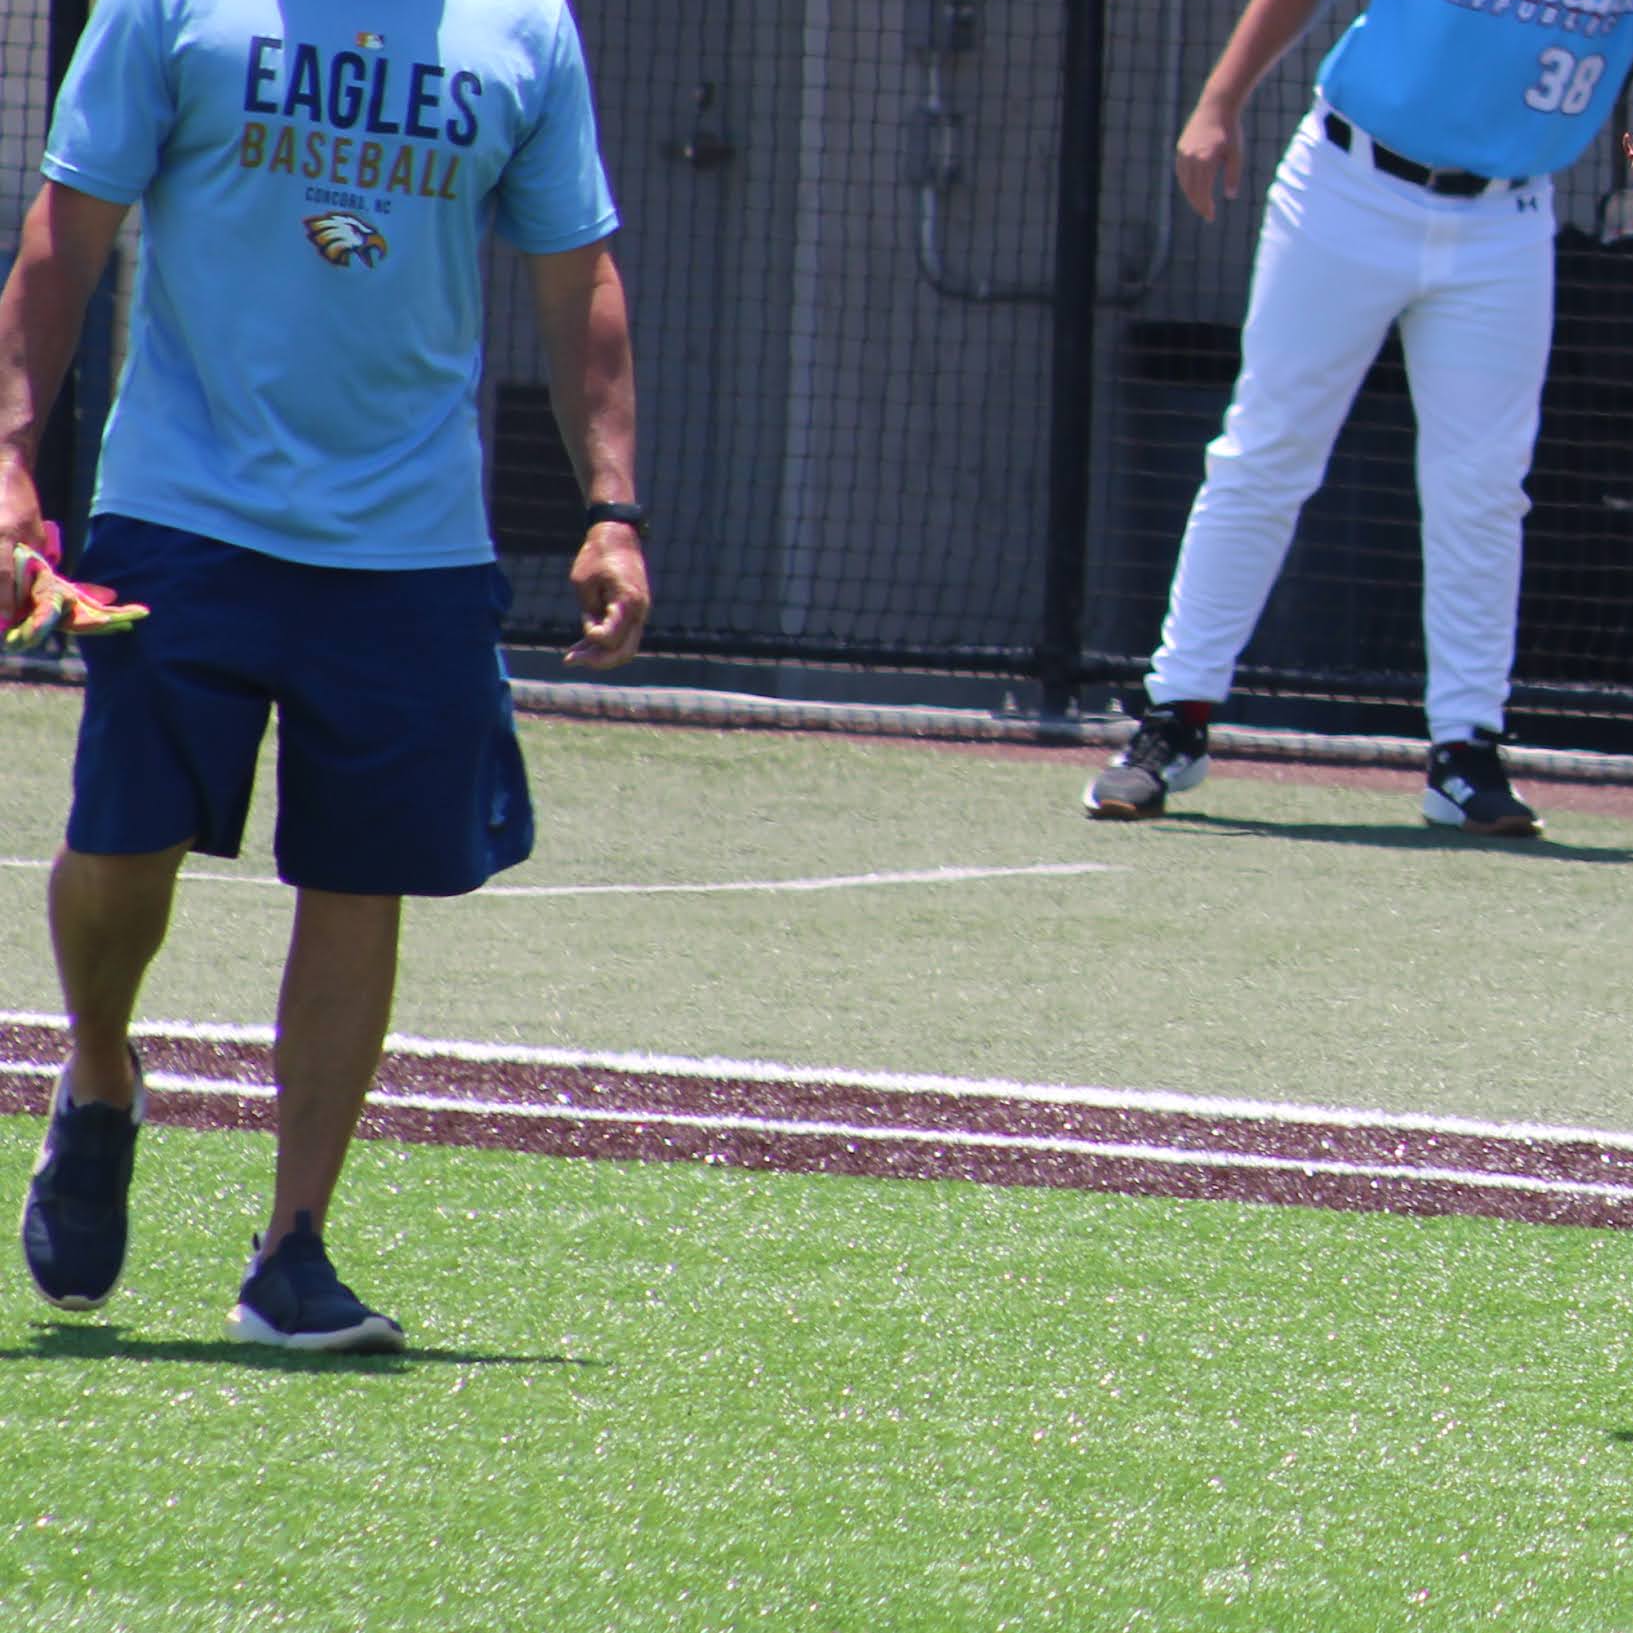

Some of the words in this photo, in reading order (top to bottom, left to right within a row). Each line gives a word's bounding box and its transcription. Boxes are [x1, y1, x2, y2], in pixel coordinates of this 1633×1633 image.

[244, 35, 482, 147] EAGLES
[1523, 45, 1606, 115] 38
[240, 121, 461, 201] BASEBALL
[374, 199, 392, 215] NC
